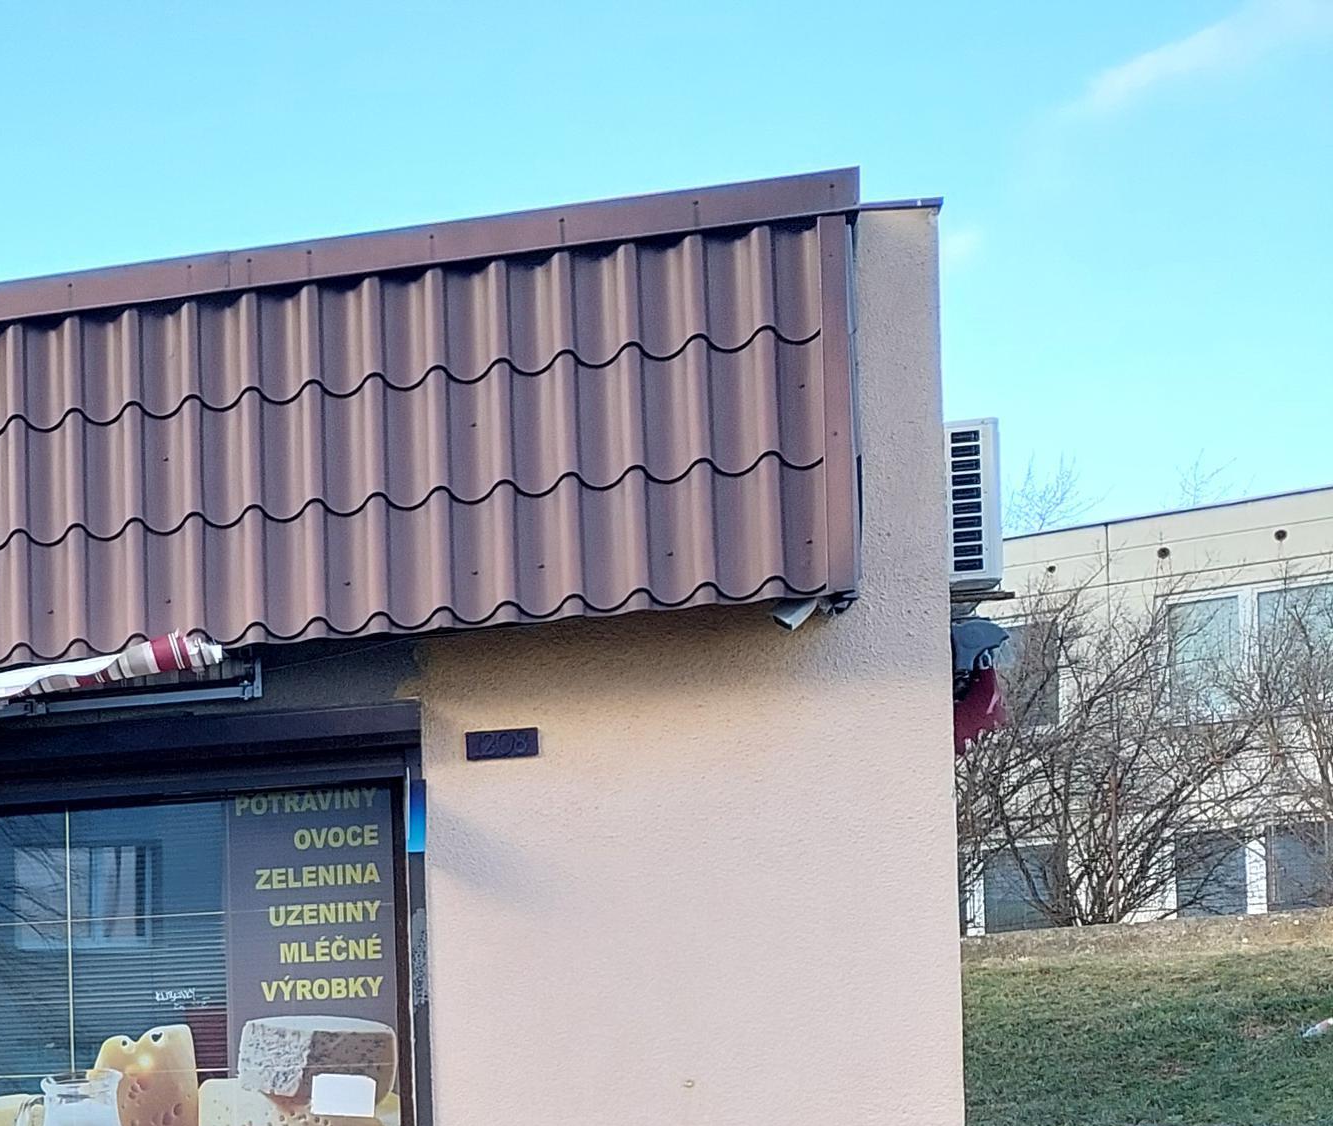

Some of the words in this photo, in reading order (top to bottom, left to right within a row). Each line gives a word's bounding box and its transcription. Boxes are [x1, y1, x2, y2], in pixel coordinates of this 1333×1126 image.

[235, 788, 377, 816] POTRAVINY
[294, 825, 379, 850] OVOCE
[255, 863, 381, 889] ZELENINA
[269, 901, 381, 926] UZENINY
[280, 933, 382, 963] MLÉČNÉ
[261, 976, 383, 1001] VÝROBKY
